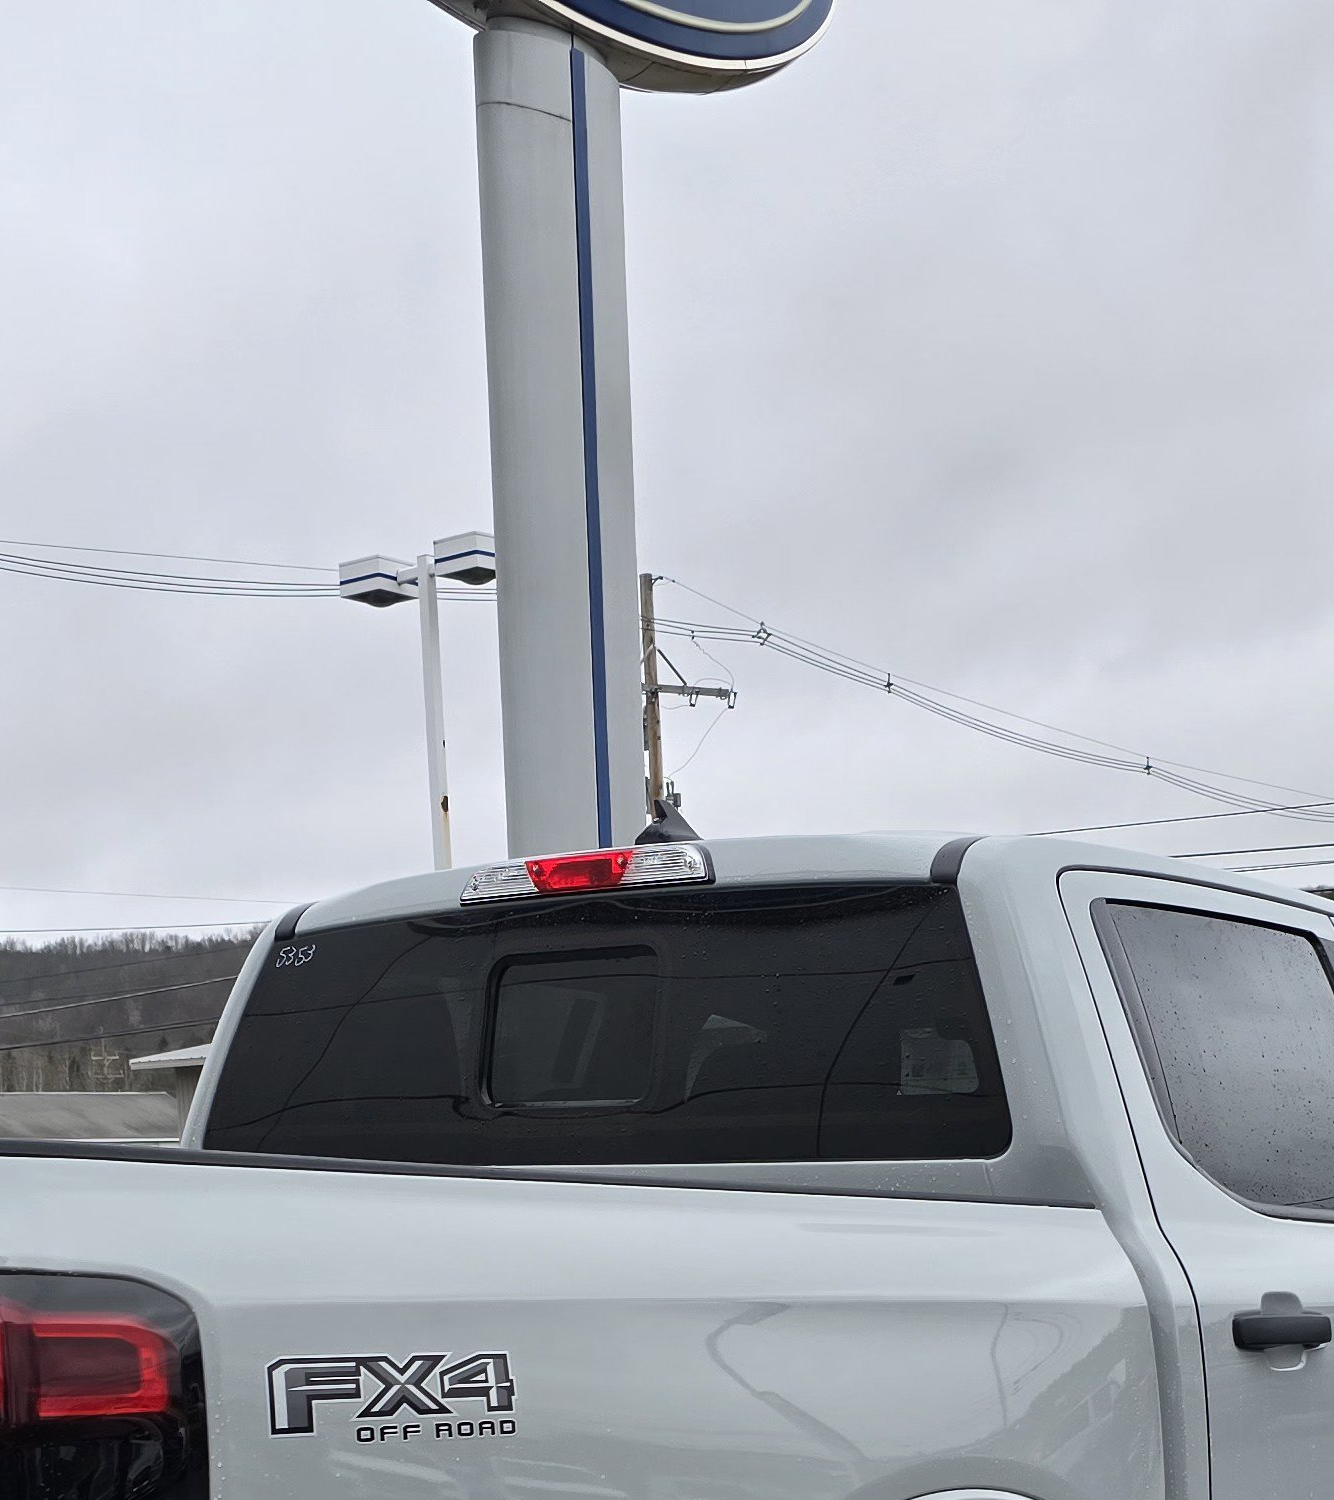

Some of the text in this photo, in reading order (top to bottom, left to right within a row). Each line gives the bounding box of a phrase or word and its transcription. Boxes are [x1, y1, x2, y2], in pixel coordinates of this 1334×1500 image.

[276, 944, 316, 968] 5353
[265, 1351, 517, 1439] FX4
[356, 1419, 517, 1444] OFF ROAD
